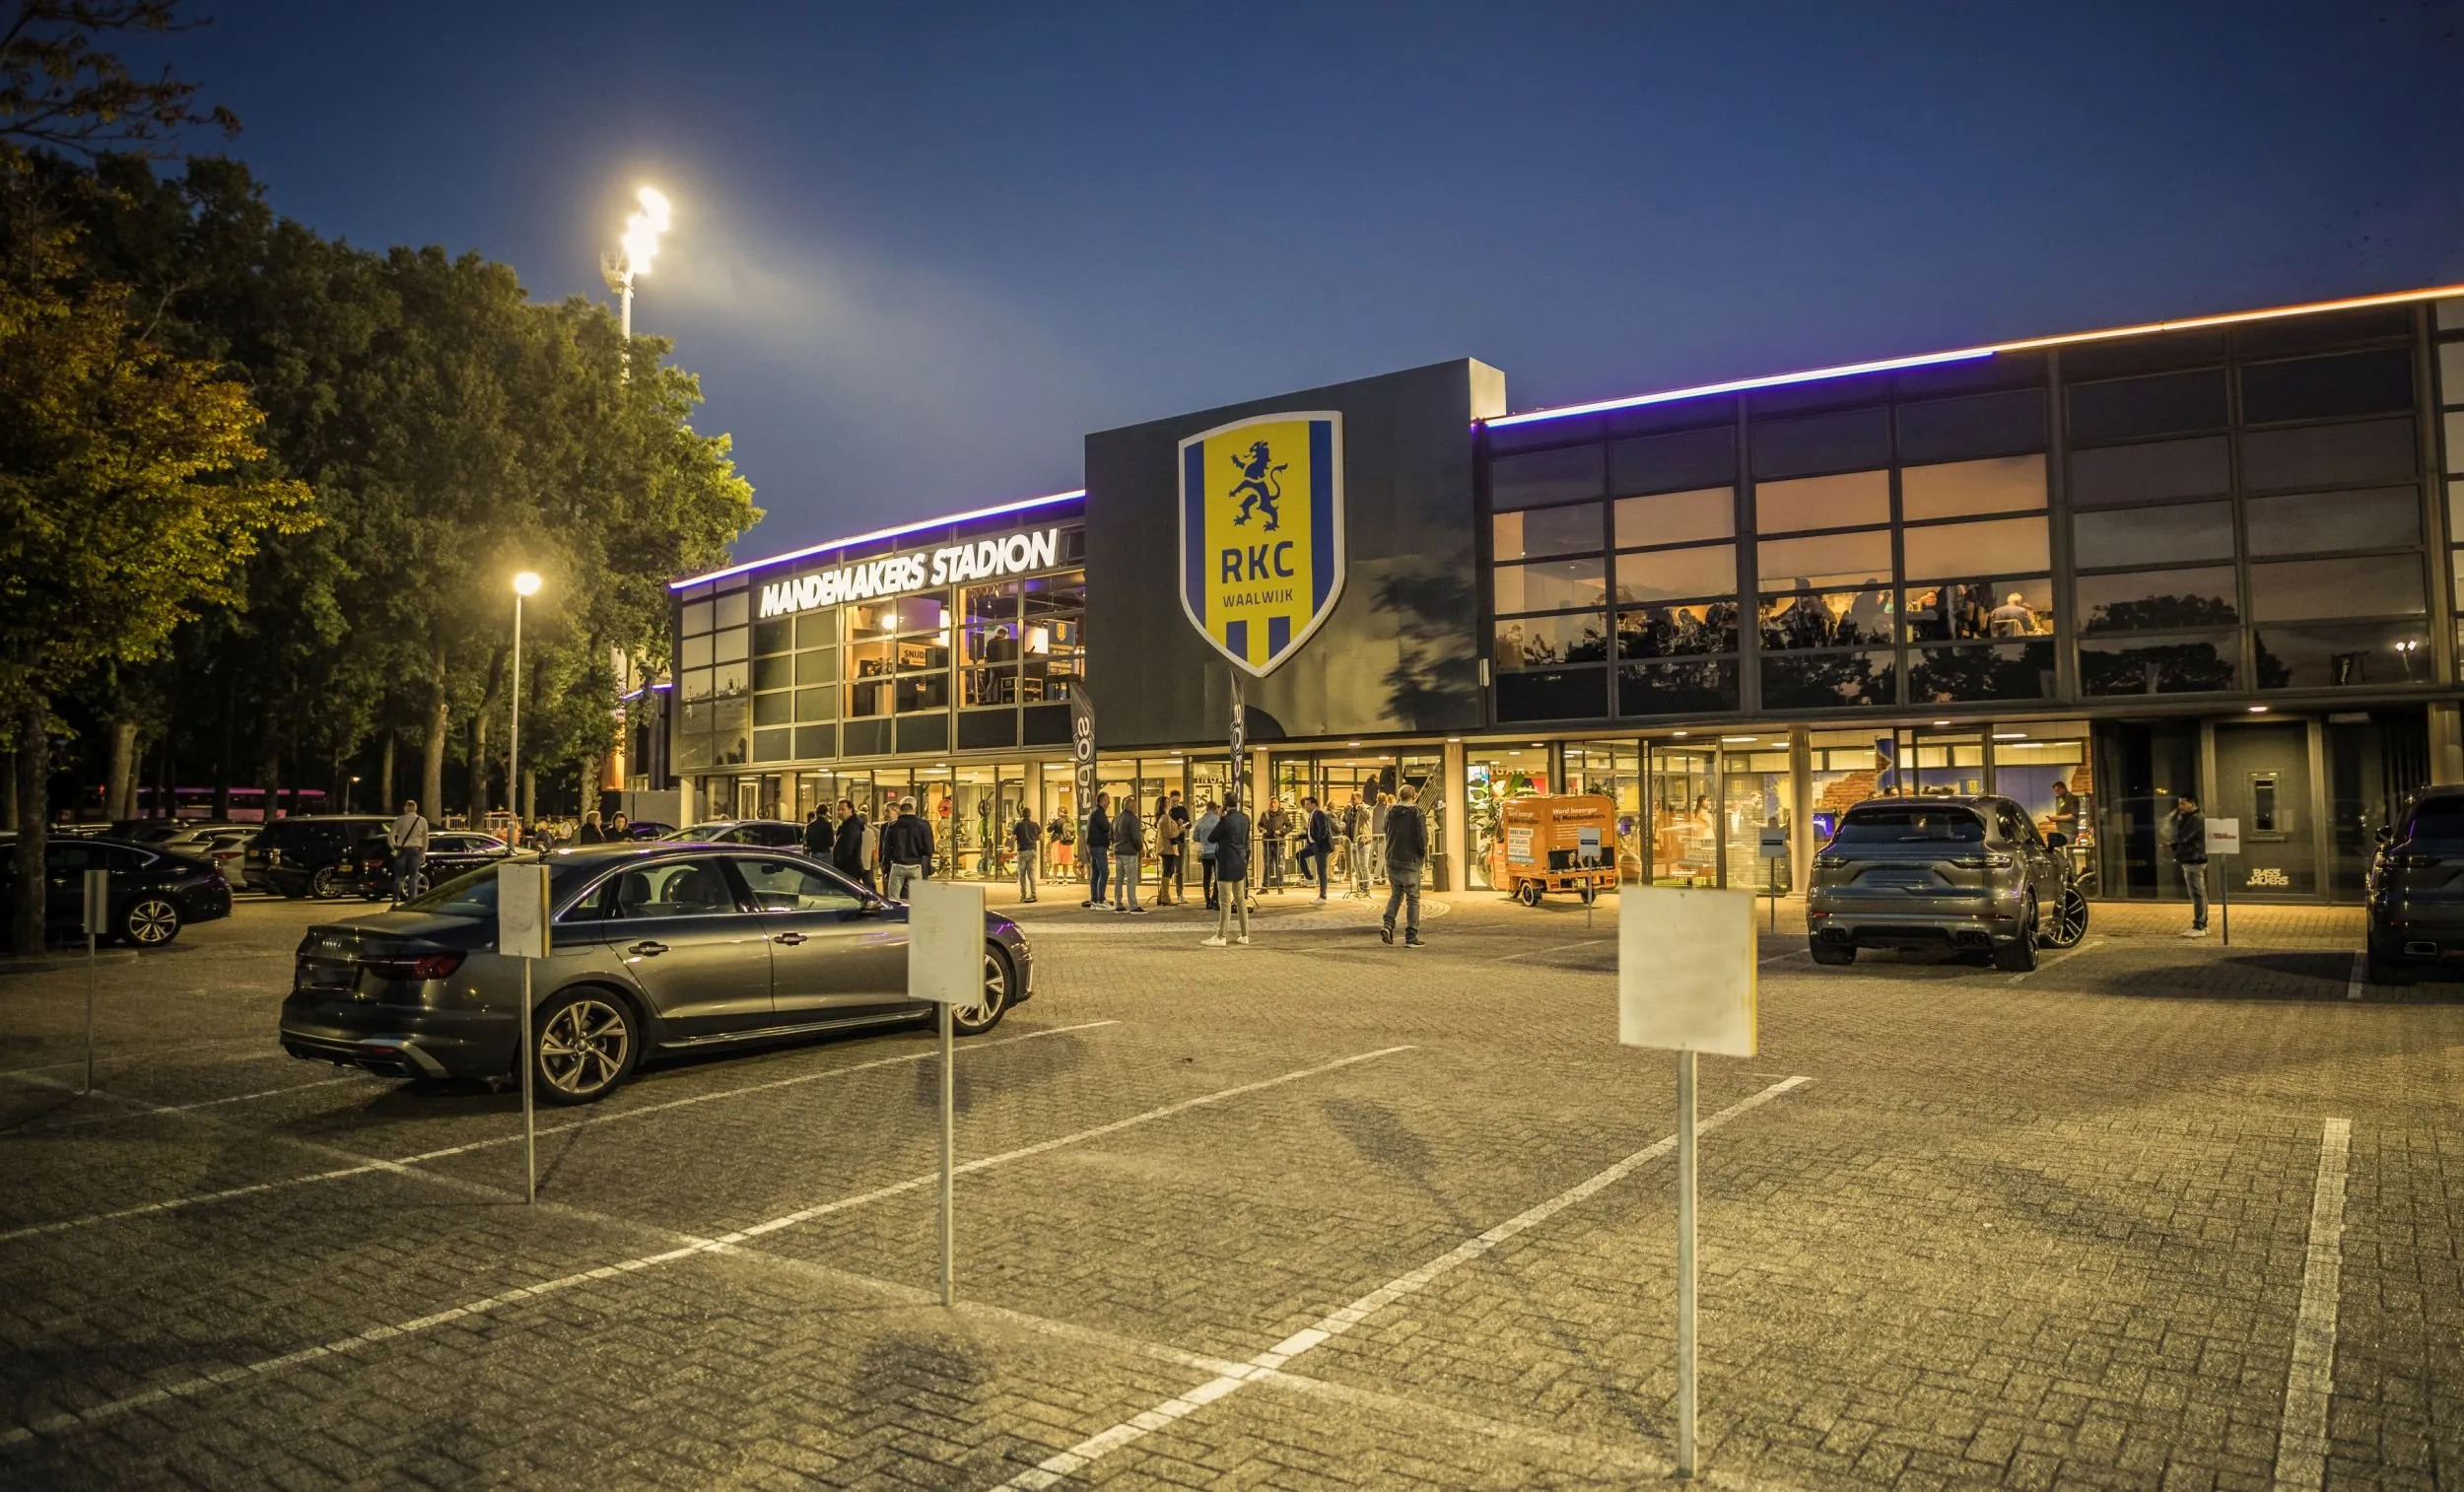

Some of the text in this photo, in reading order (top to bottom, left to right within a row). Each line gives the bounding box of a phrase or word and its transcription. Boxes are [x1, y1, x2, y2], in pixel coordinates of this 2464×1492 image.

[1222, 541, 1293, 583] RKC
[760, 528, 1058, 618] MANDEMAKERS STADION
[1223, 589, 1293, 608] WAALWIJK
[904, 649, 925, 659] SNIJD
[1198, 774, 1232, 783] INGAN
